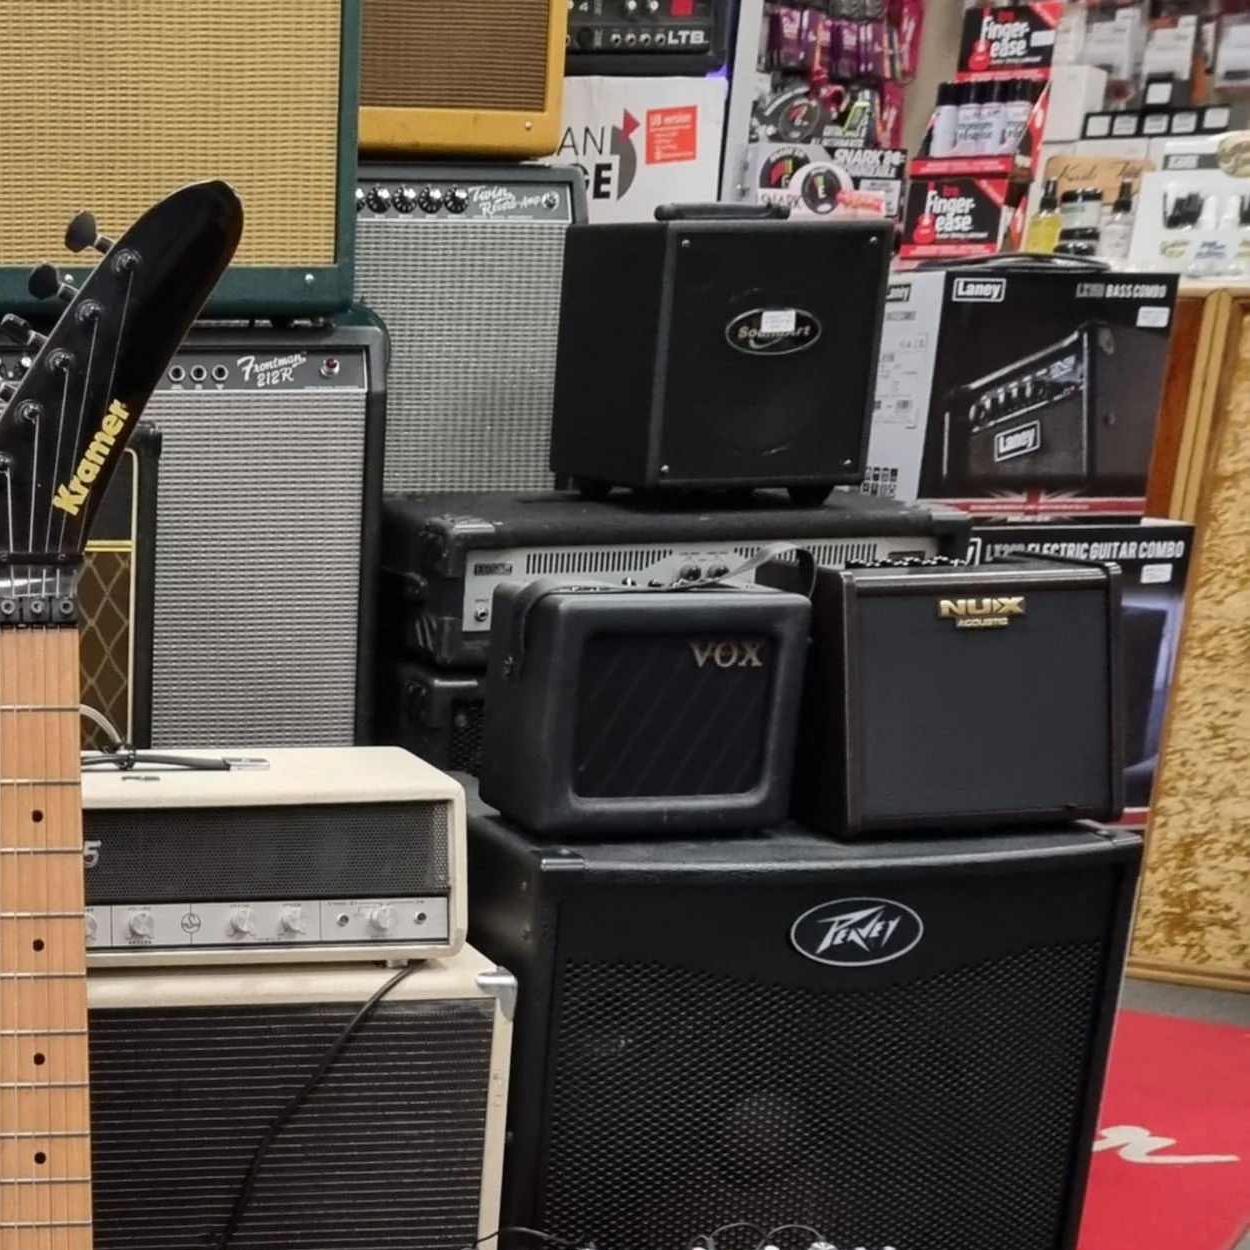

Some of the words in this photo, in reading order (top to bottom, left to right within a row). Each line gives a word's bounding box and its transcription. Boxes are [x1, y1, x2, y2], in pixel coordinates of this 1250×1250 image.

[957, 281, 1001, 299] Laney
[1105, 284, 1132, 298] BASS
[1133, 284, 1168, 298] COMBO
[236, 353, 307, 381] Frontman
[256, 368, 295, 388] 212R
[999, 428, 1036, 453] Laney
[52, 399, 130, 516] Kramer
[1089, 542, 1138, 560] GUITAR
[1138, 540, 1186, 559] COMBO
[940, 596, 1025, 615] NUX
[957, 617, 1009, 628] ACOUSTIC
[692, 642, 764, 668] VOX
